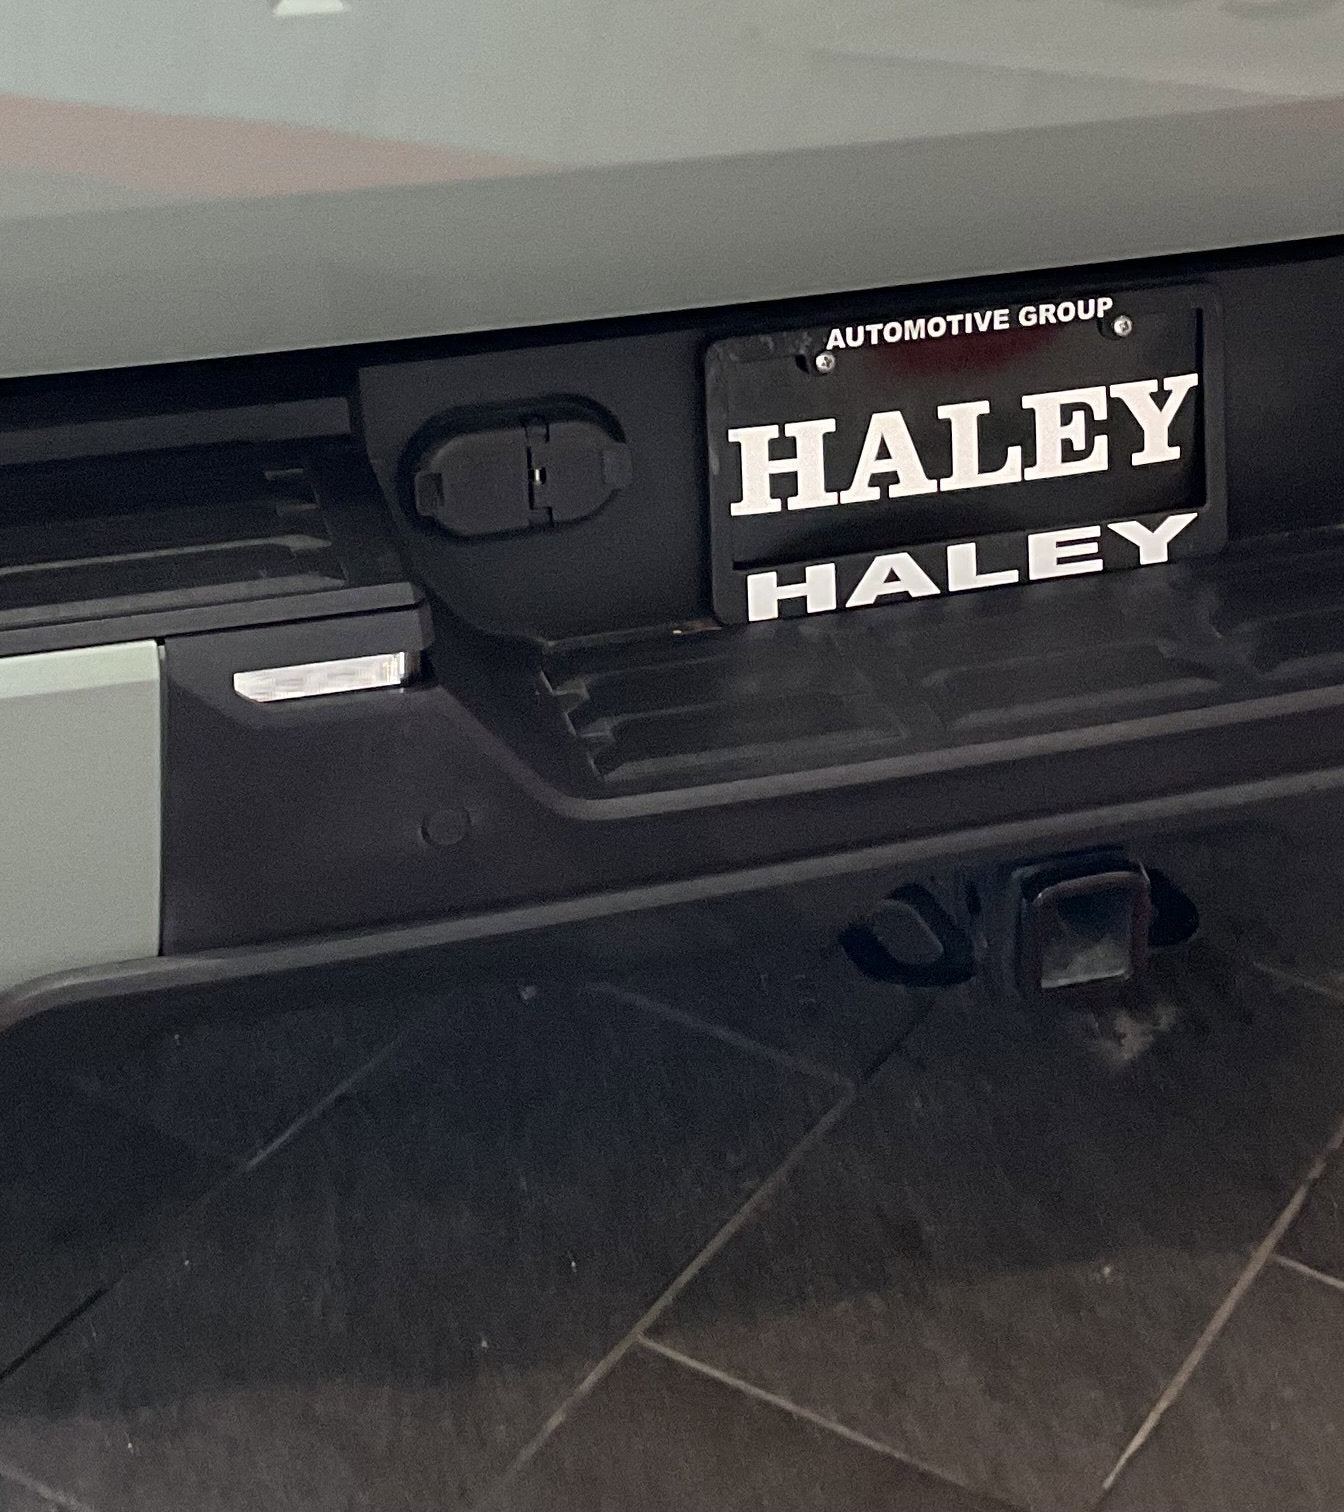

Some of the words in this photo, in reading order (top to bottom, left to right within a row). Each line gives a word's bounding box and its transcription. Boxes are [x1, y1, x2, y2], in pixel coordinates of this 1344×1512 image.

[825, 308, 1011, 350] AUTOMOTIVE
[1017, 296, 1114, 328] GROUP
[727, 372, 1199, 517] HALEY
[746, 511, 1198, 622] HALEY
